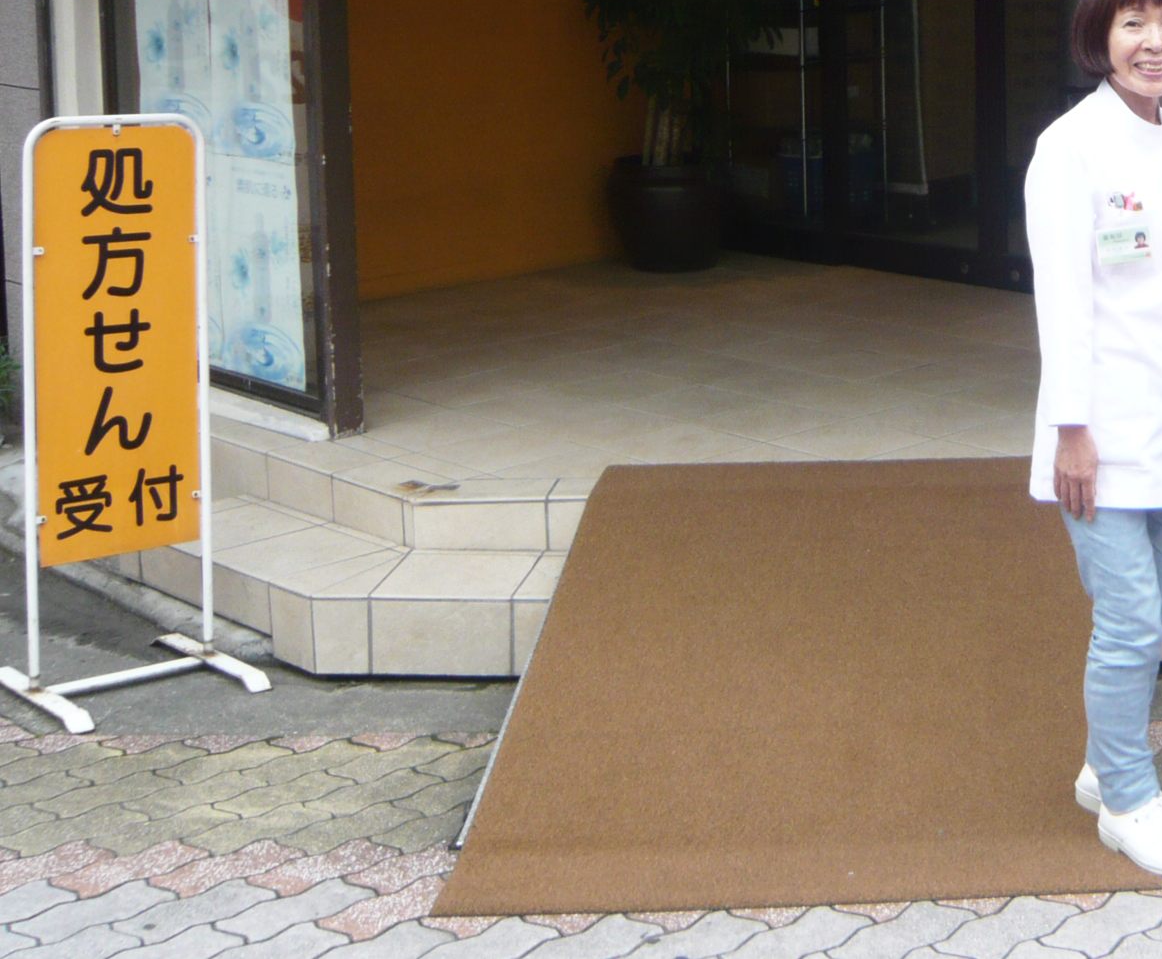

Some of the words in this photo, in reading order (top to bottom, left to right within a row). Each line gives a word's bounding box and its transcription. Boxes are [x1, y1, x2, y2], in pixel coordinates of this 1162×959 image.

[80, 147, 154, 456] 処方せん
[54, 464, 185, 541] 受付
